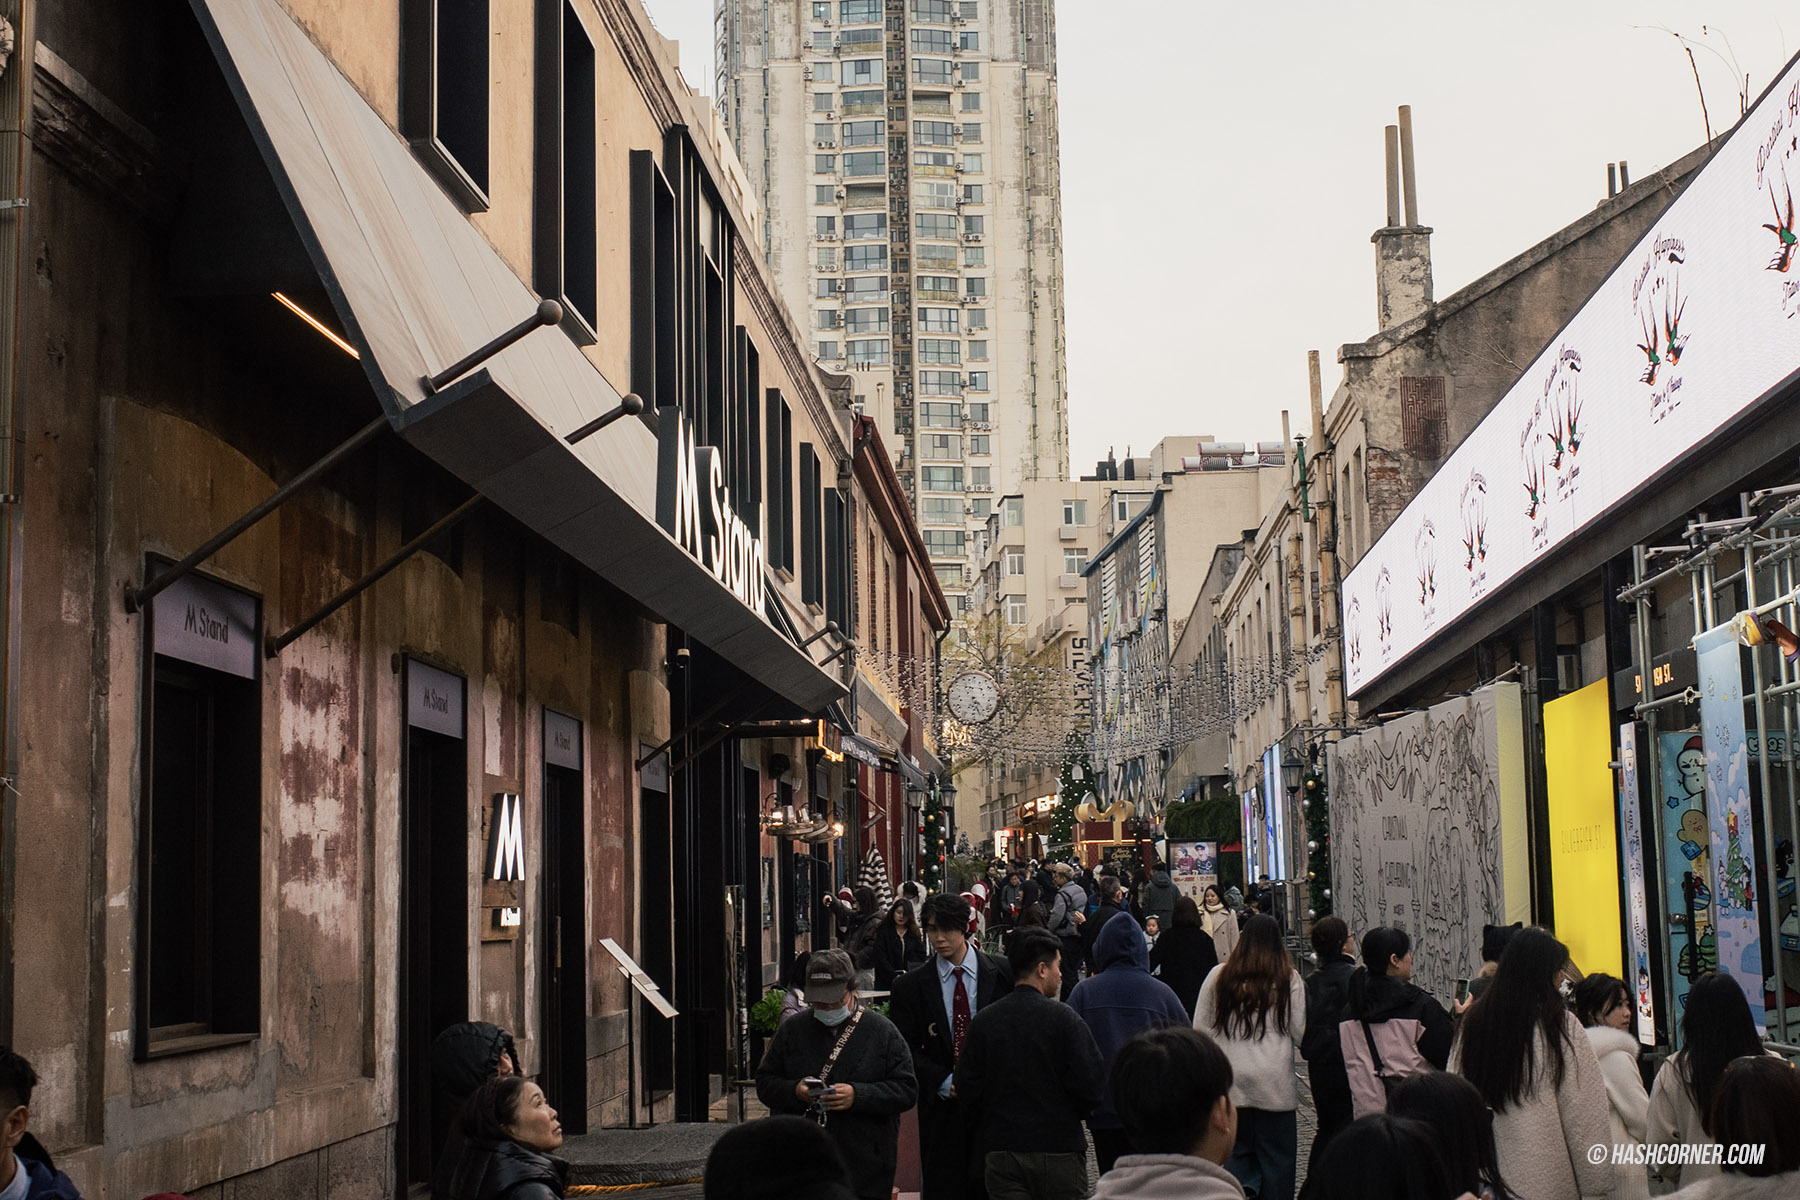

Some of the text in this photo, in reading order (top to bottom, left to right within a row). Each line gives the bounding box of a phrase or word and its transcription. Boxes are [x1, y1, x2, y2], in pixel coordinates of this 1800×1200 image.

[675, 408, 765, 618] M Stand
[183, 602, 229, 644] M Stand
[423, 686, 449, 714] M Stand
[493, 792, 525, 881] M
[836, 1025, 856, 1048] TRAVEL
